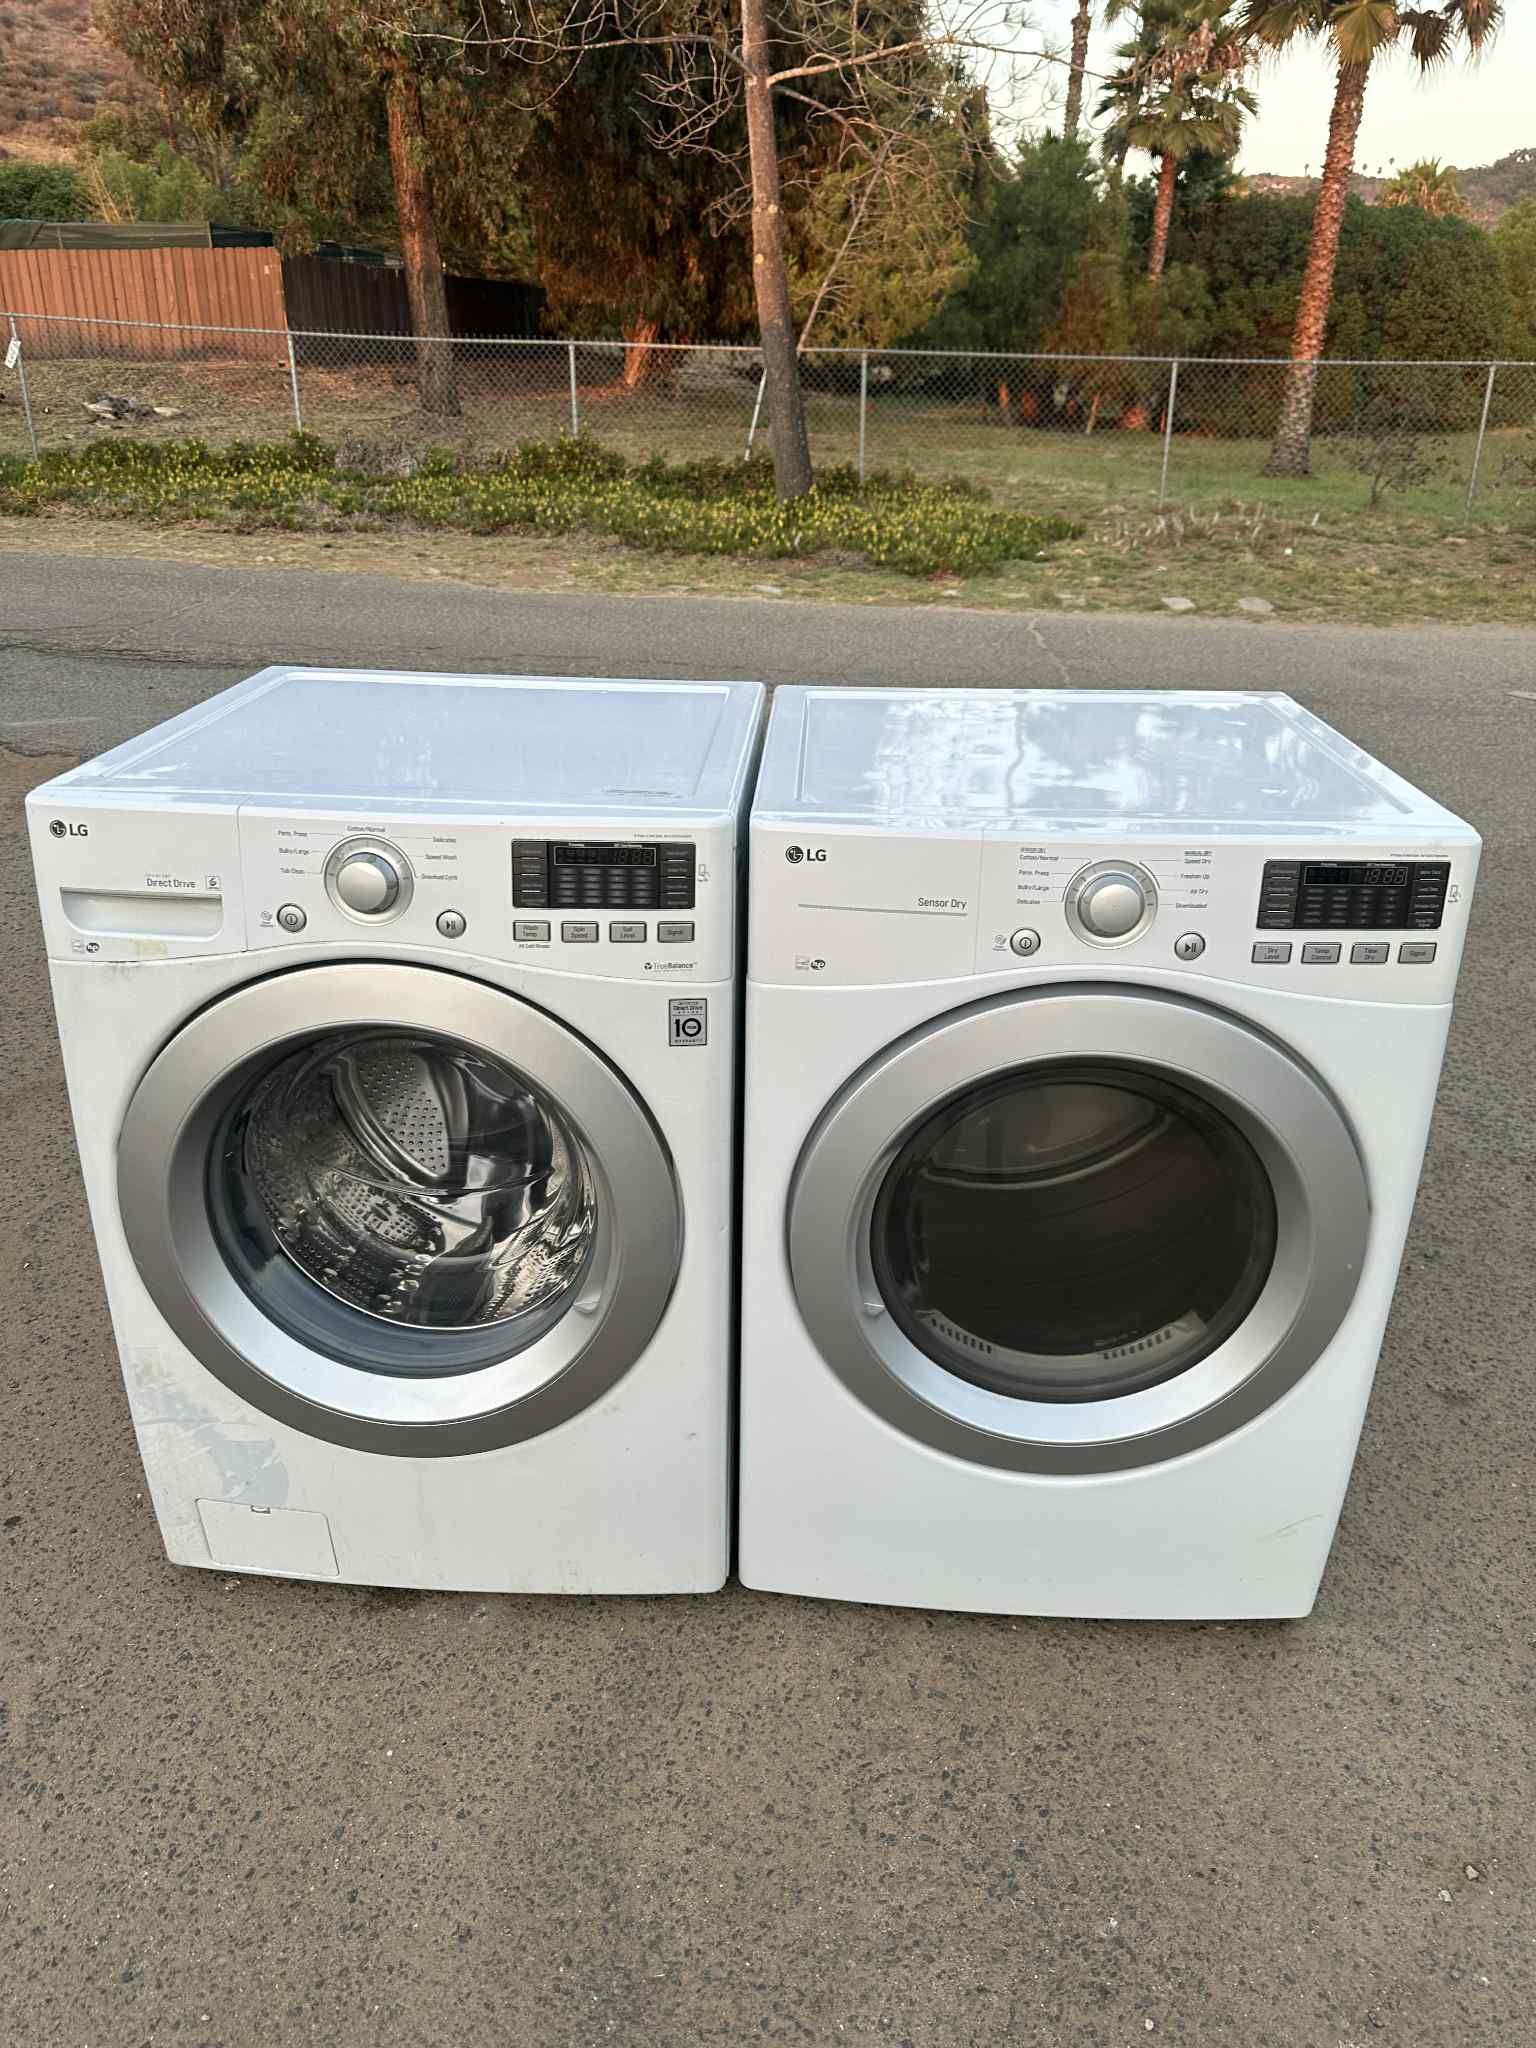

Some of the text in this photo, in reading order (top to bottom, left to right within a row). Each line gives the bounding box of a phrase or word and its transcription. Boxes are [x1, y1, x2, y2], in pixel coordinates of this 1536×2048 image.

[69, 823, 88, 837] LG
[806, 848, 827, 862] LG
[146, 878, 196, 889] Direct Drive
[917, 897, 967, 910] Sensor Dry
[675, 1017, 702, 1038] 10
